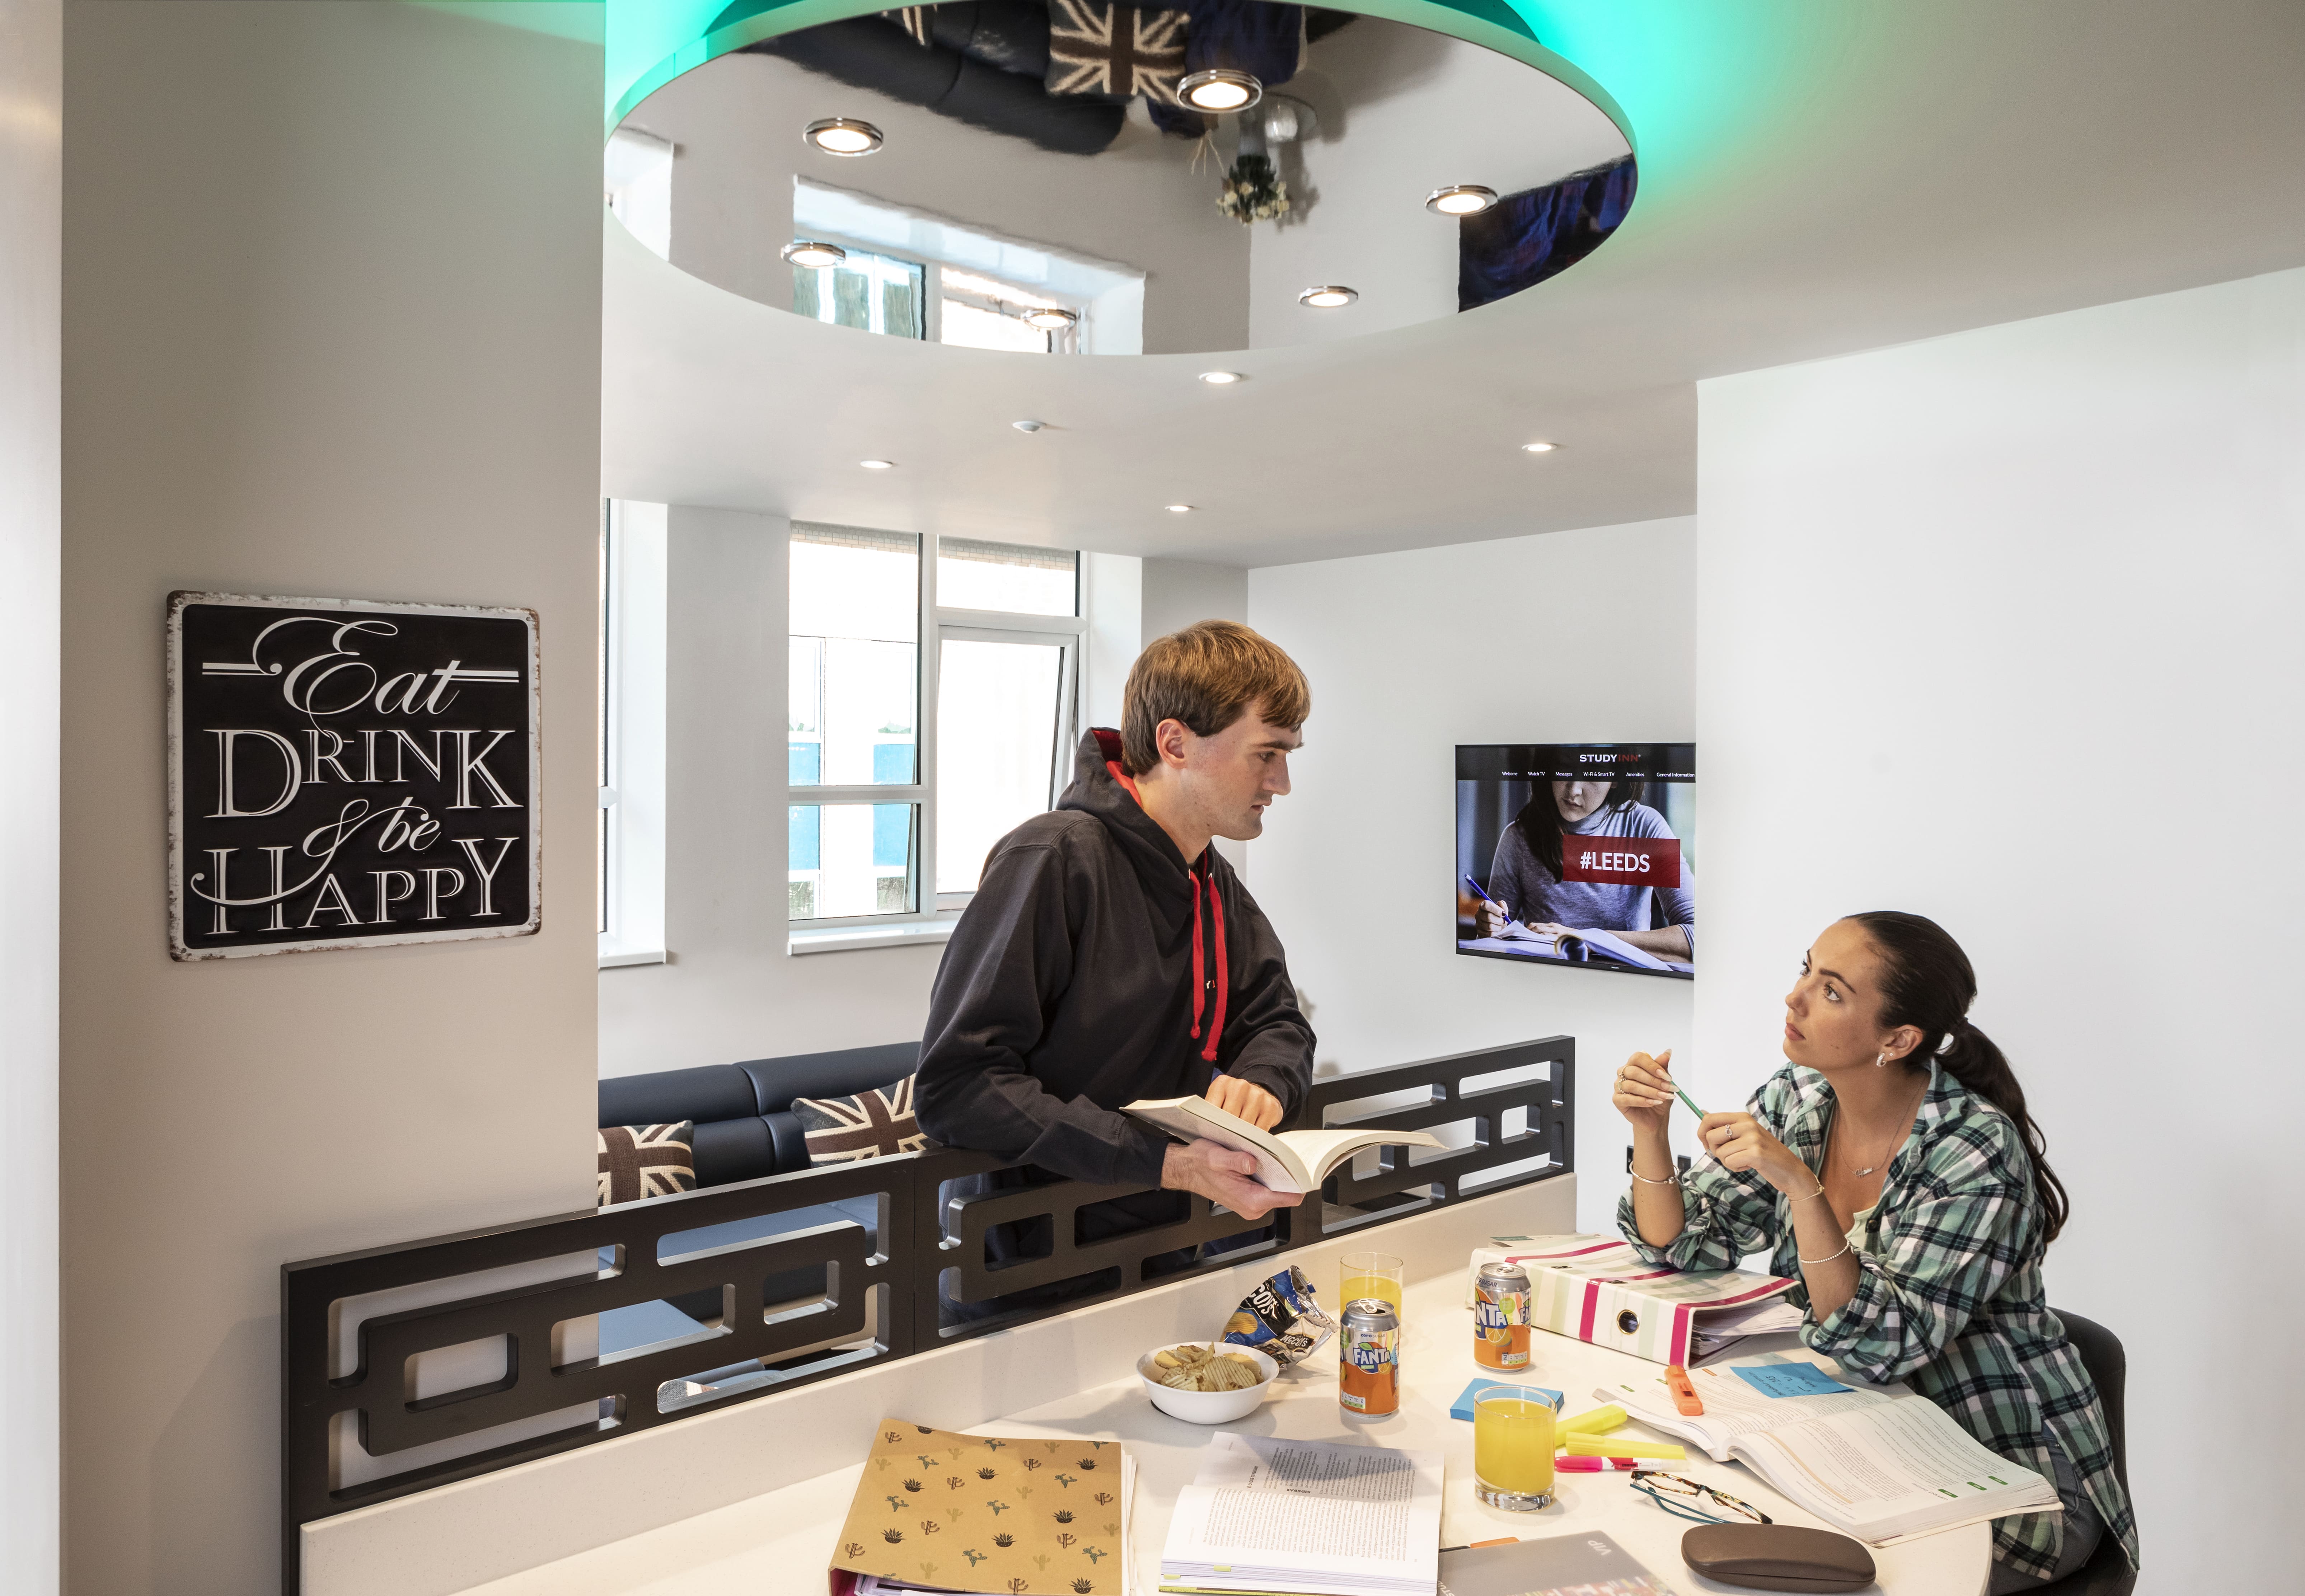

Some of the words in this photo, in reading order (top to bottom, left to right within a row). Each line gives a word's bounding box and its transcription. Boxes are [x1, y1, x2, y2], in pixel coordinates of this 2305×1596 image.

[252, 616, 461, 717] Eat
[202, 728, 524, 818] DRINK
[378, 796, 441, 853] be
[1580, 851, 1650, 872] #LEEDS
[192, 837, 520, 935] HAPPY
[1481, 1278, 1498, 1287] SUGAR
[1353, 1348, 1391, 1364] FANTA
[1588, 1540, 1611, 1555] VIP
